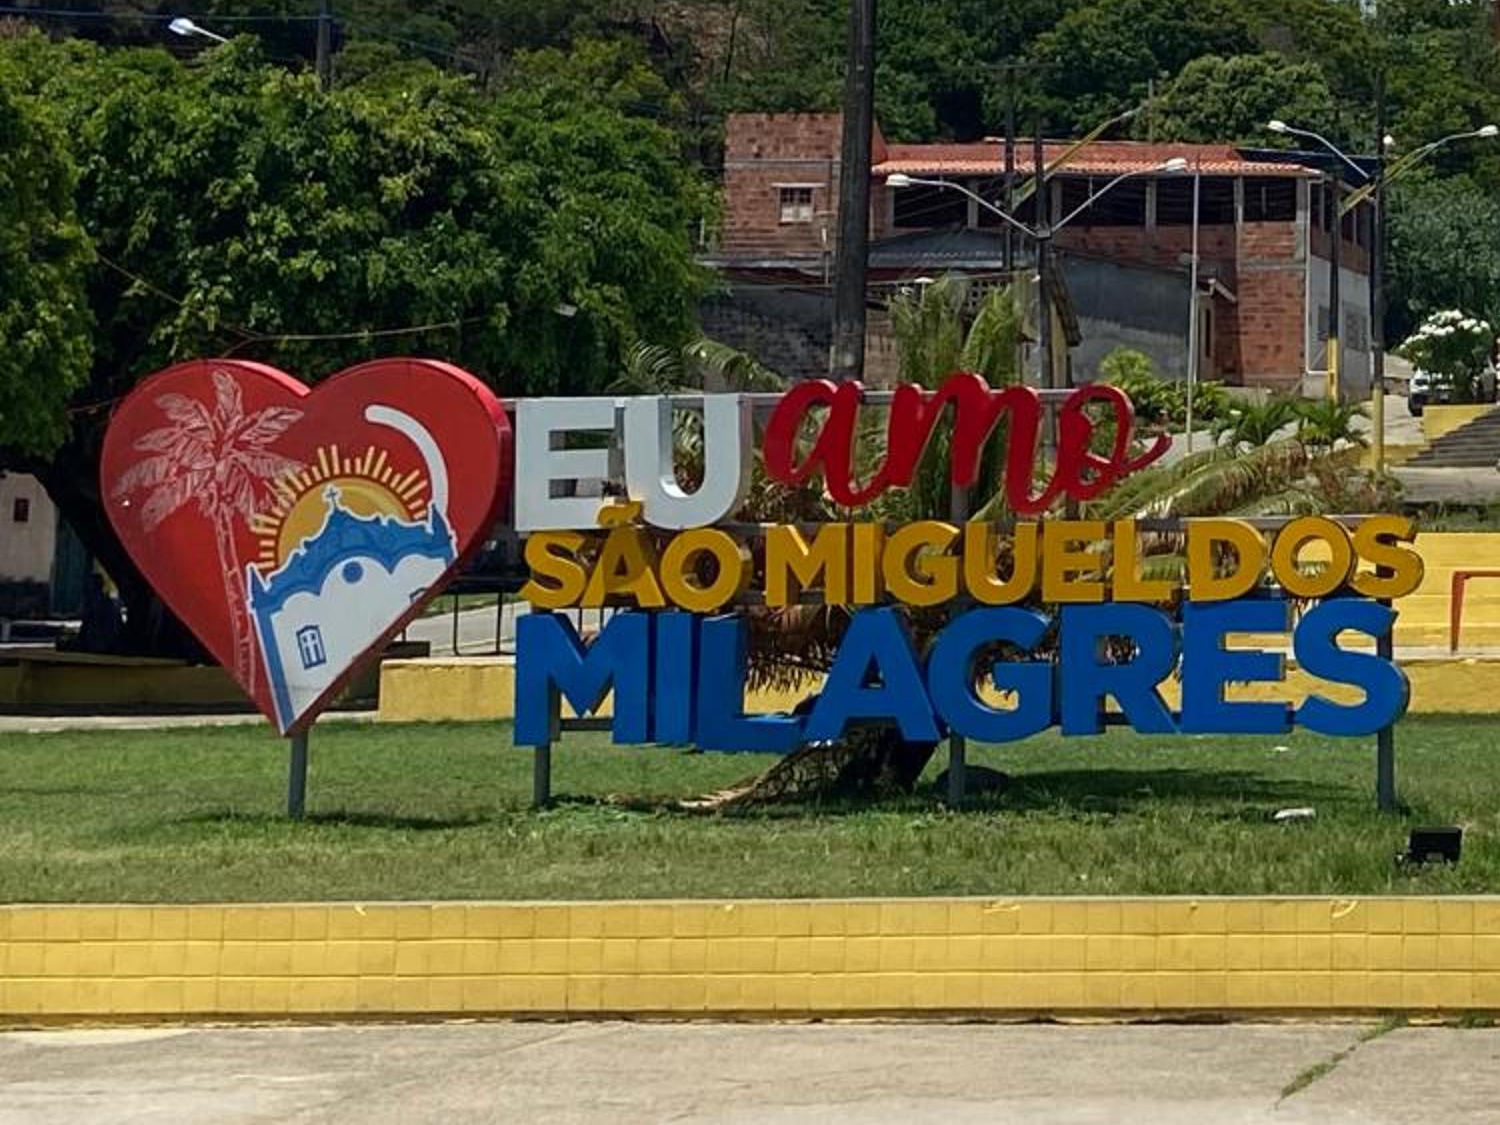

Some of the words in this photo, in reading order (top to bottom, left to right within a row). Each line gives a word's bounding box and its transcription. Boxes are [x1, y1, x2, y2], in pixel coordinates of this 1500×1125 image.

[515, 393, 752, 532] EU
[764, 372, 1172, 514] amo
[519, 497, 752, 612] SÃO
[764, 520, 1176, 607] MIGUEL
[1186, 515, 1425, 603] DOS
[513, 598, 1410, 751] MILAGRES
